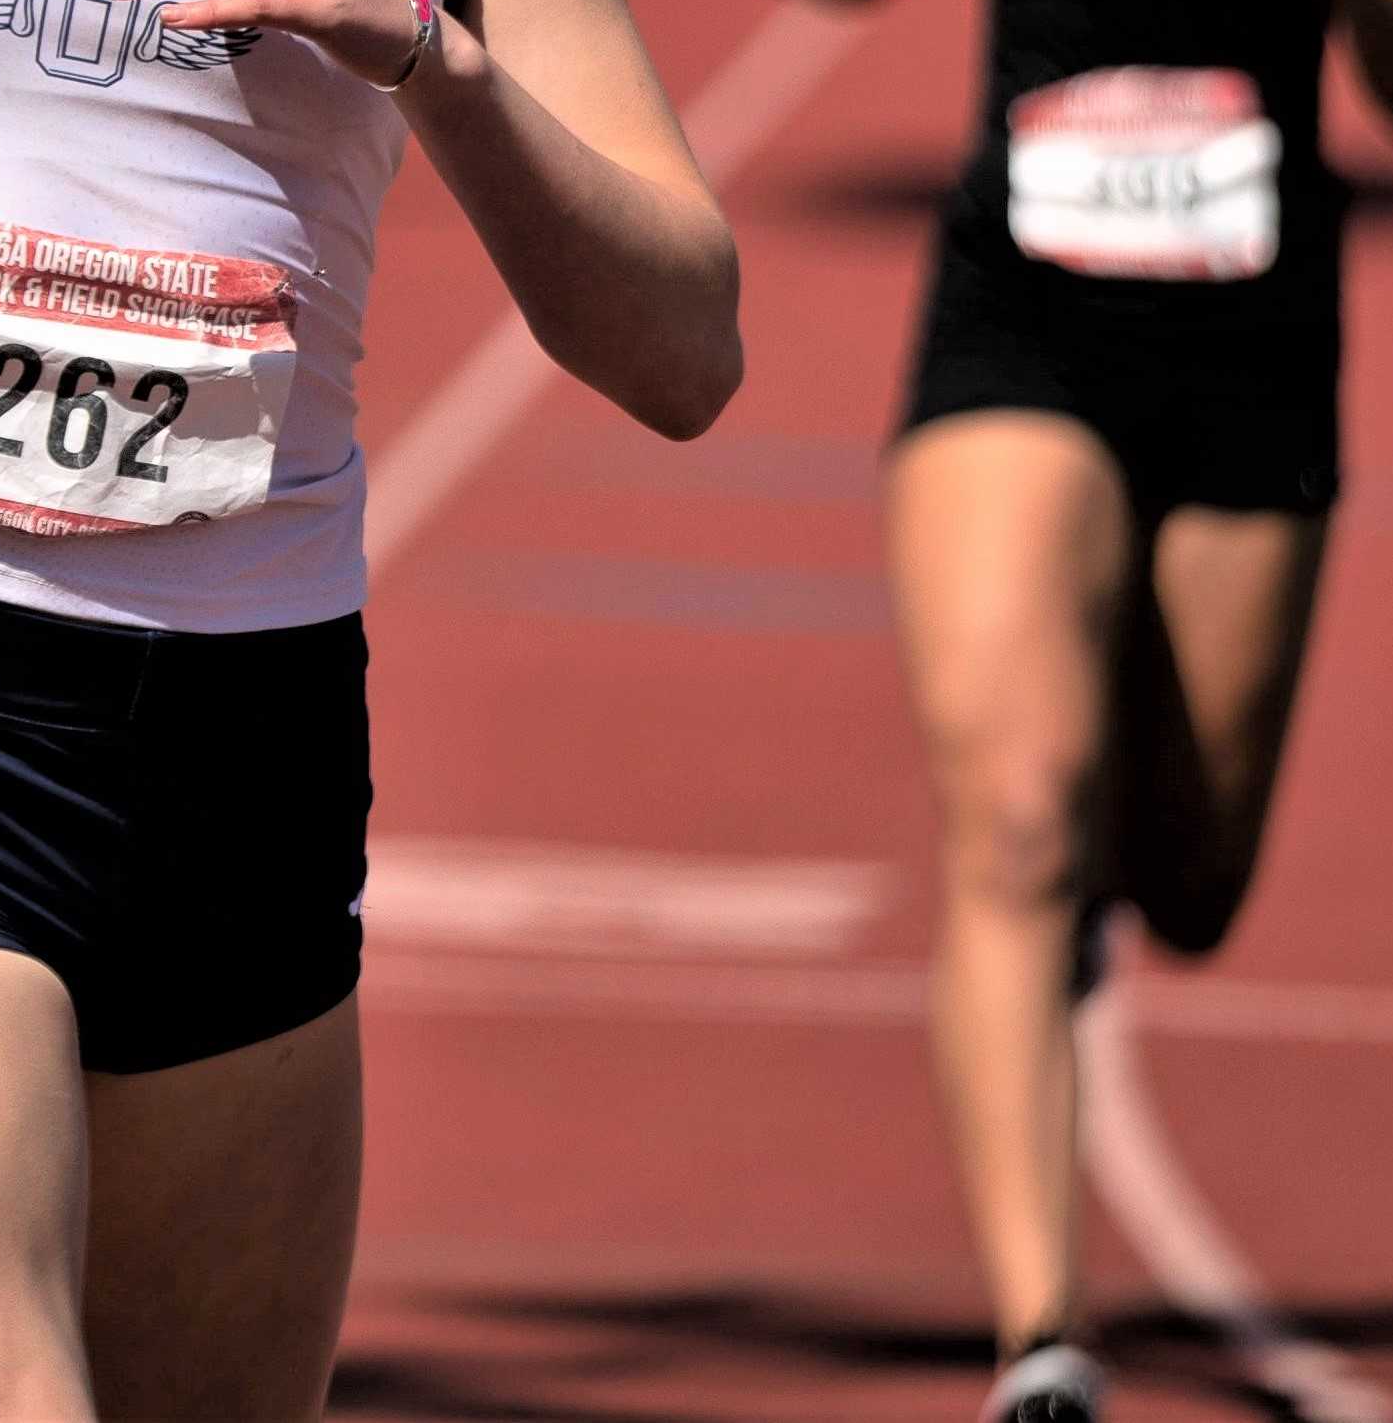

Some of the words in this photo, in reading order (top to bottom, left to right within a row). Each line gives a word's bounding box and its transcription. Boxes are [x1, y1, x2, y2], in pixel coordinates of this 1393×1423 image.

[33, 237, 137, 287] OREGON
[142, 255, 219, 299] STATE
[23, 277, 43, 307] &
[46, 280, 121, 319] FIELD
[124, 293, 261, 342] SHOWCASE
